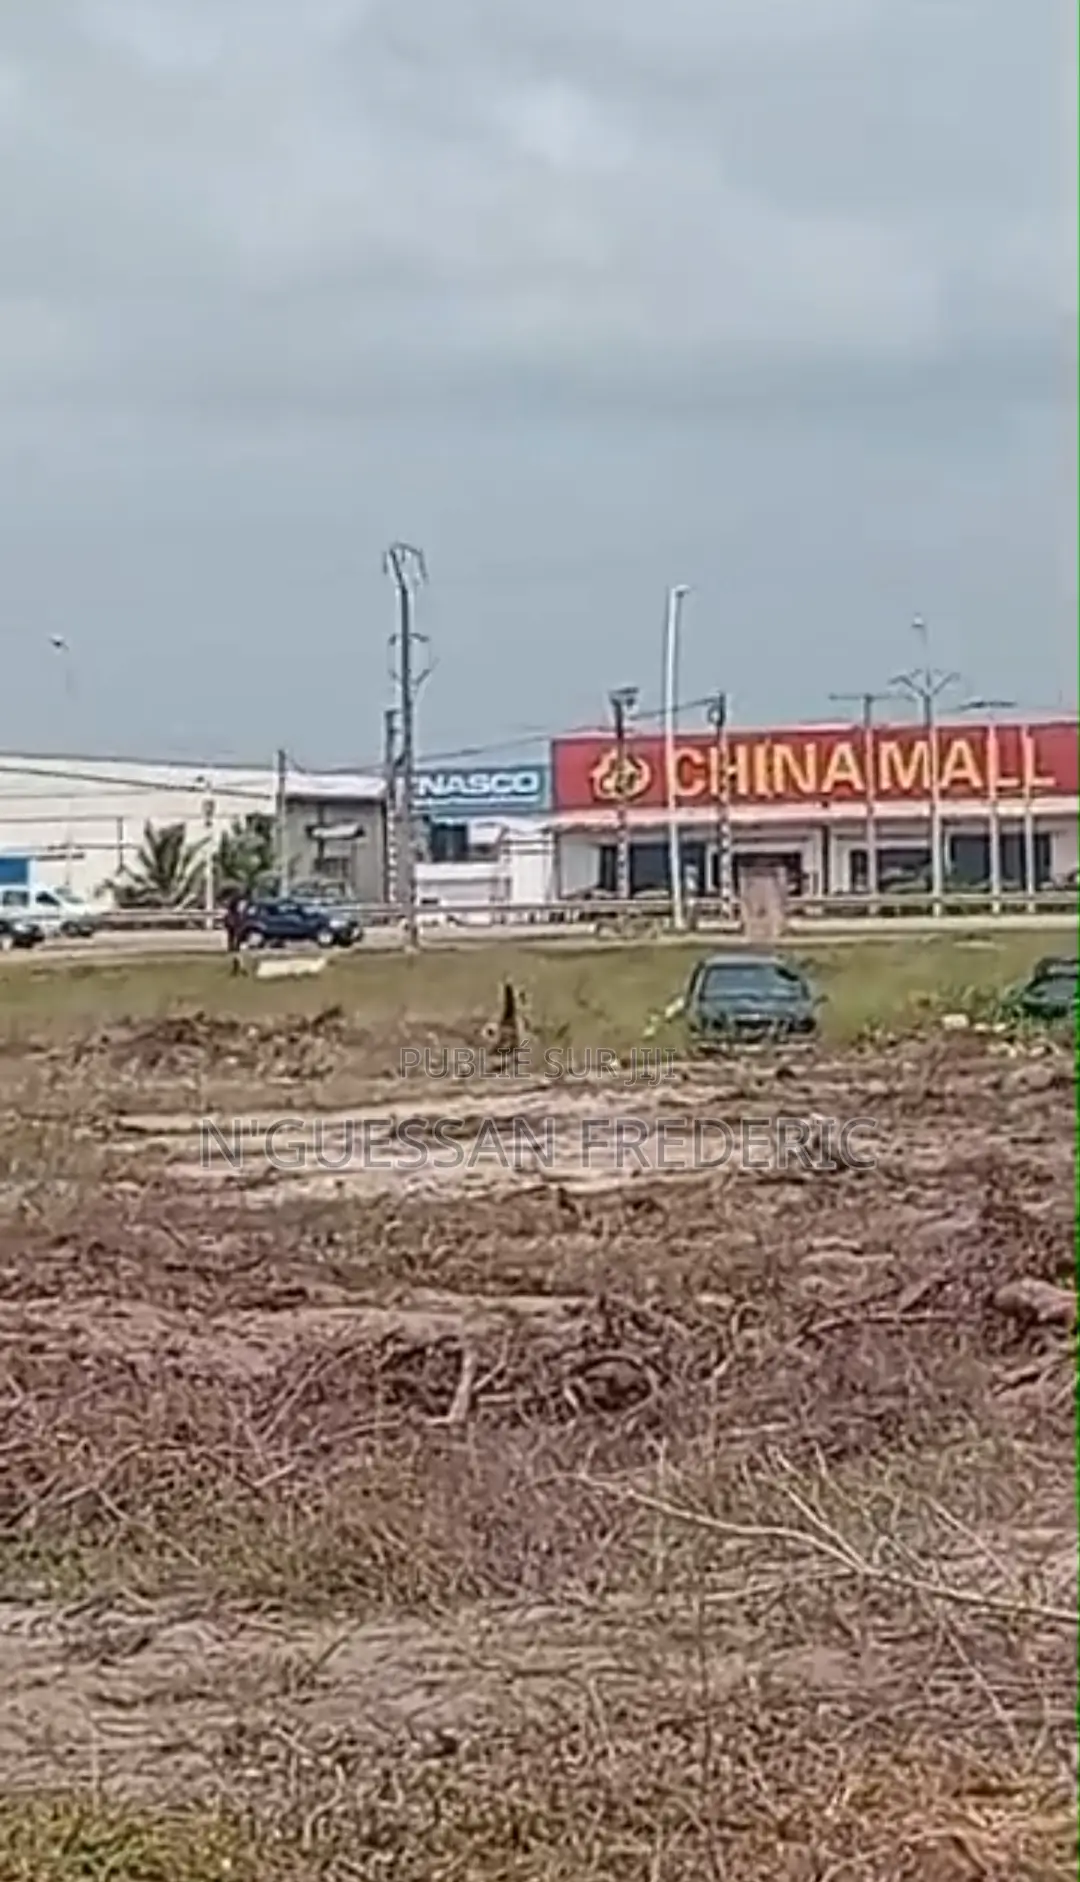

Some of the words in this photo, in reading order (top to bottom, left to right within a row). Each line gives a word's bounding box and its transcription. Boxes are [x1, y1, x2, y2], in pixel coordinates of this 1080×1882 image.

[417, 772, 539, 796] NASCO
[674, 741, 865, 797] CHINA
[880, 737, 1056, 792] MALL
